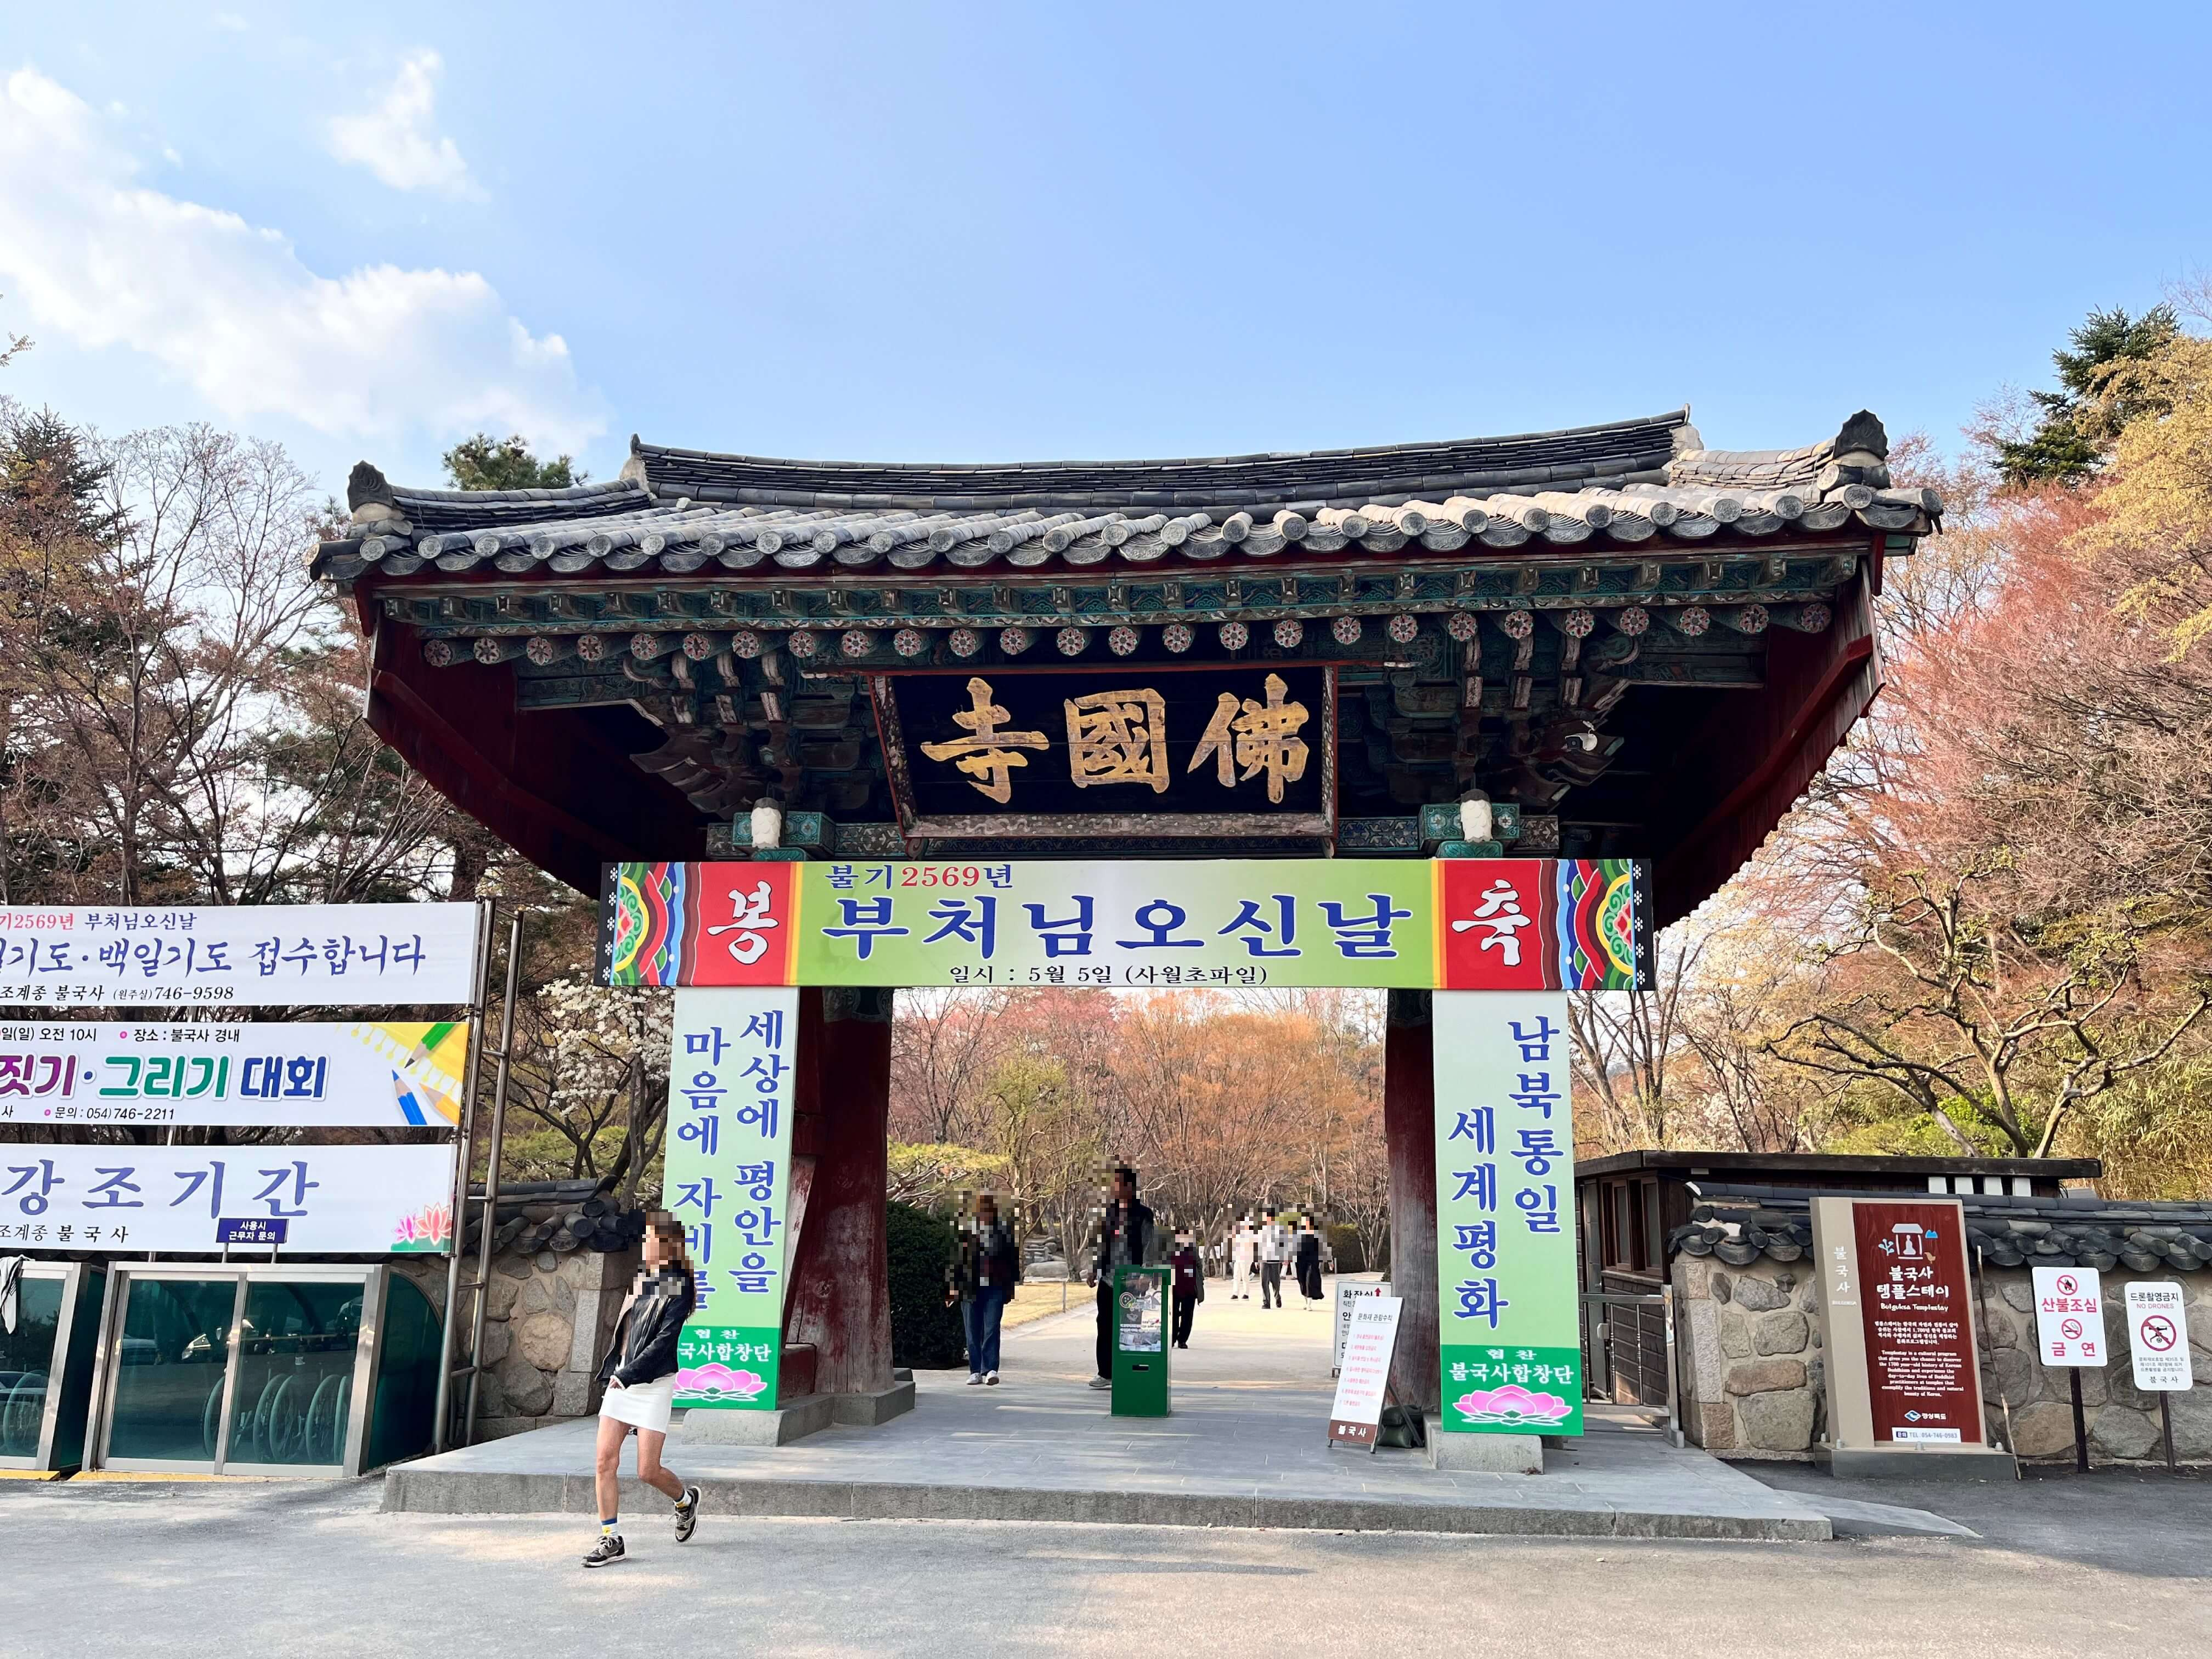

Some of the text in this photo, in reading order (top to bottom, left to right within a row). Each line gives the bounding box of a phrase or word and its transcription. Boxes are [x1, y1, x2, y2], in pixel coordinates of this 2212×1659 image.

[85, 912, 197, 931] 부처님오신날
[706, 880, 780, 964] 봉
[821, 893, 1412, 961] 부처님오신날
[1451, 878, 1532, 967] 축
[0, 934, 425, 978] 기도·백일기도 접수합니다
[950, 965, 994, 984] 일시
[1029, 965, 1065, 984] 5월
[1078, 965, 1112, 984] 5일
[1125, 964, 1268, 984] (사월초파일)
[0, 985, 46, 1001] 조계종
[55, 984, 105, 1001] 불국사
[1, 1026, 35, 1041] 일(일)
[39, 1027, 64, 1041] 오전
[70, 1028, 97, 1042] 10시
[133, 1028, 159, 1043] 장소
[171, 1029, 209, 1043] 불국사
[215, 1029, 240, 1043] 경내
[240, 1056, 326, 1097] 대회
[737, 1009, 790, 1138] 세상에
[677, 1026, 731, 1155] 마음에
[55, 1107, 77, 1119] 문의
[86, 1107, 175, 1120] 054)746-2211
[1507, 1015, 1564, 1234] 남북통일
[1, 1159, 319, 1219] 강조기간
[240, 1221, 266, 1231] 사용시
[728, 1161, 782, 1293] 평안을
[1447, 1106, 1509, 1329] 세계평화
[0, 1224, 129, 1243] 조계종 불국사
[229, 1231, 276, 1240] 근무자 문의
[1834, 1246, 1851, 1293] 불국사
[1889, 1265, 1934, 1281] 불국사
[1877, 1283, 1950, 1300] 템플스테이
[2130, 1292, 2179, 1302] 드론촬영금지
[1880, 1302, 1949, 1312] Bulguksa Templestay
[2042, 1298, 2098, 1312] 산불조심
[1449, 1362, 1575, 1384] 불국사합창단
[2149, 1375, 2179, 1384] 불국사
[1338, 1425, 1366, 1437] 불국사
